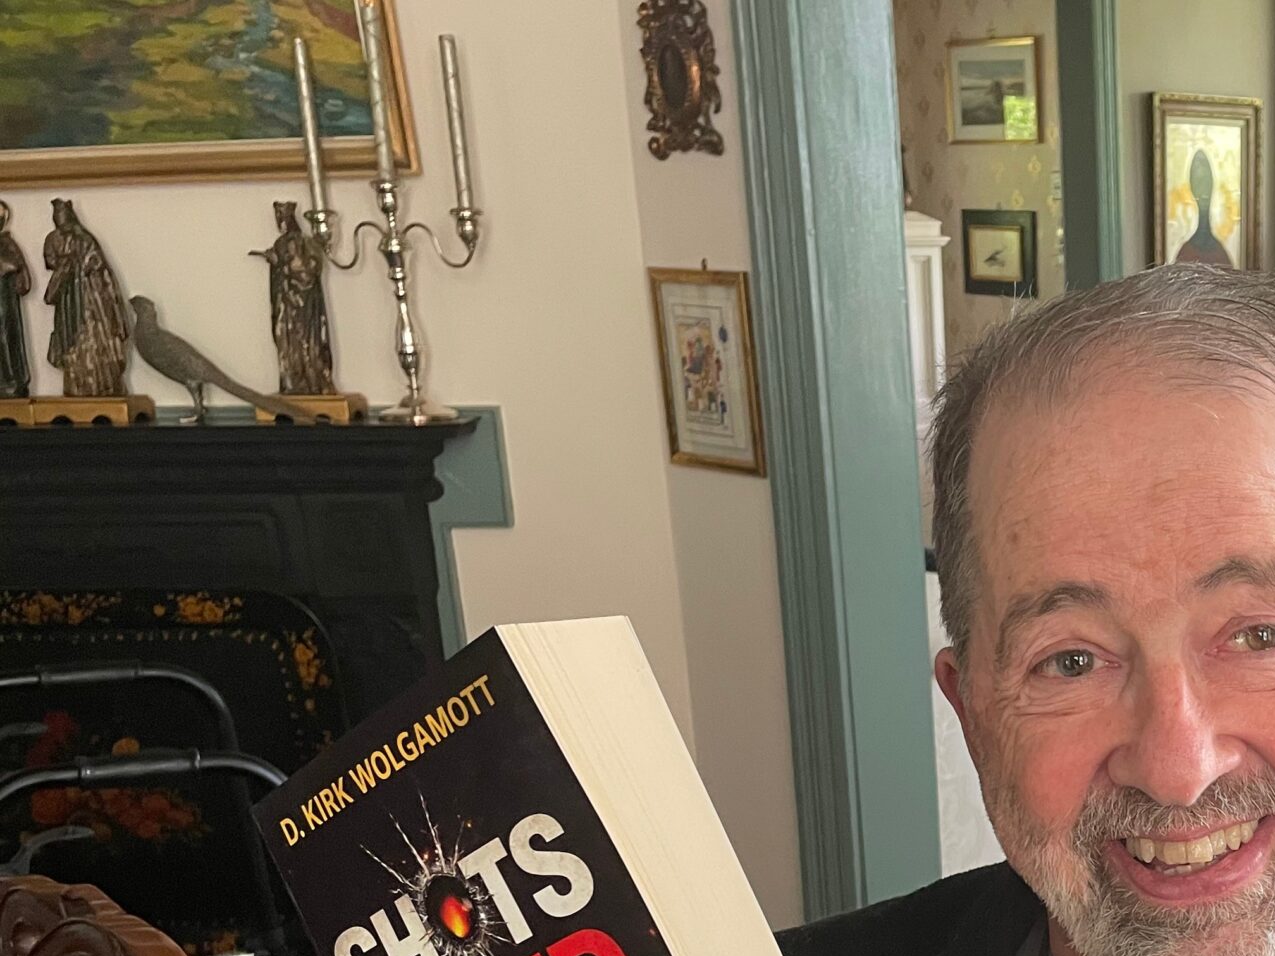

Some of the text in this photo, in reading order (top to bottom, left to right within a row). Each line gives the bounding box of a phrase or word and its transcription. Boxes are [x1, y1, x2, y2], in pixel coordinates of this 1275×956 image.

[280, 674, 496, 846] D. KIRK WOLGAMOTT
